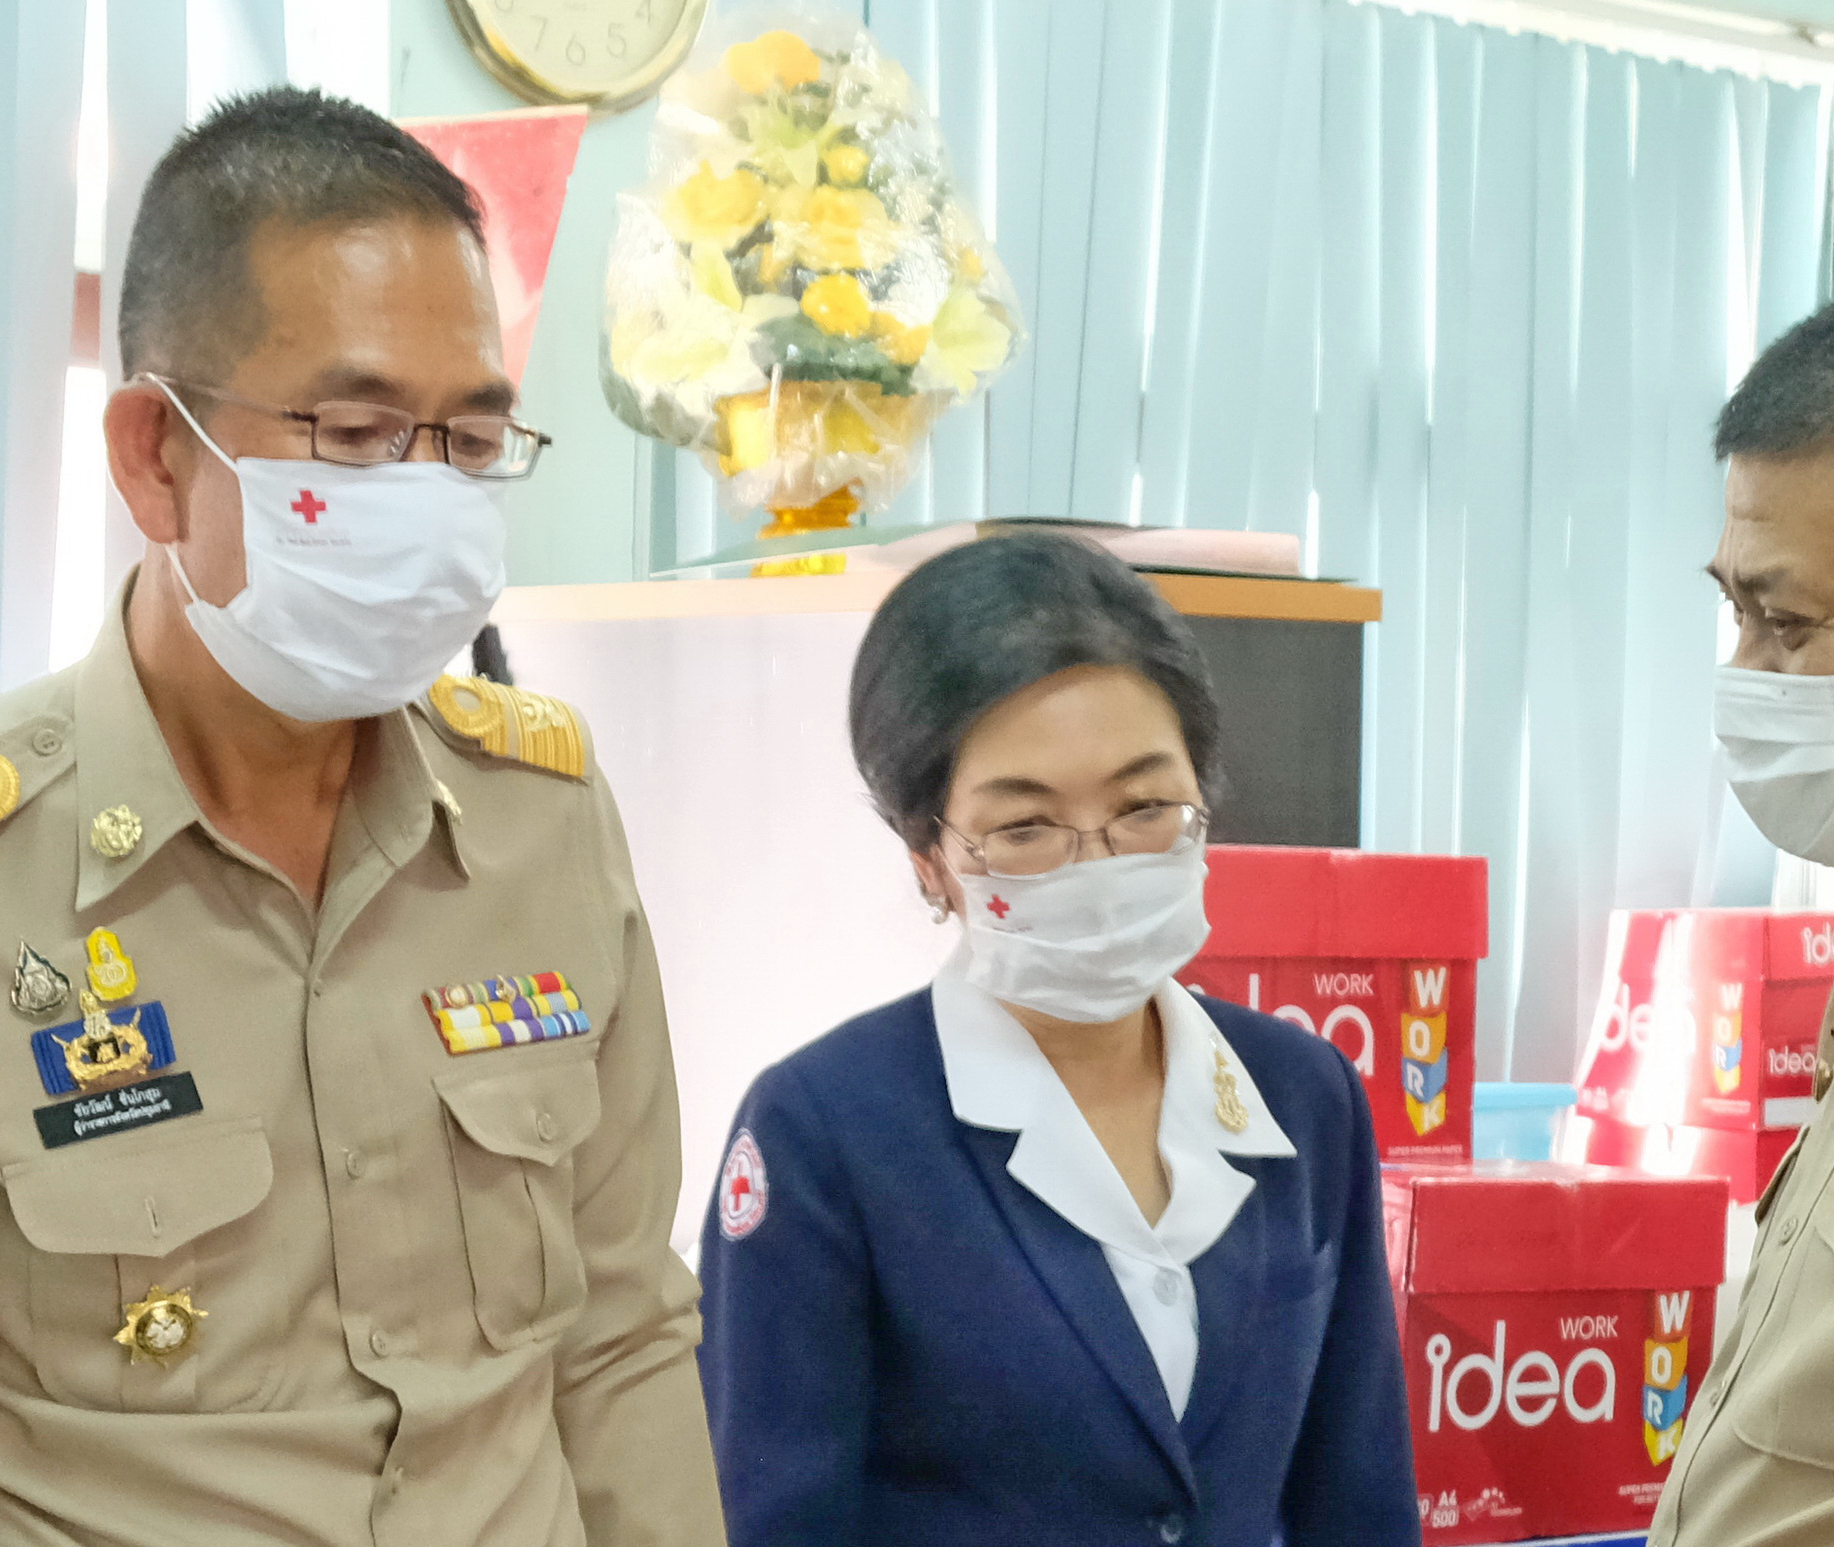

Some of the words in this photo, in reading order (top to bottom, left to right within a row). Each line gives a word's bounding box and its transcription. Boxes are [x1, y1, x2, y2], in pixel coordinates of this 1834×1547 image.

[565, 32, 586, 66] 6
[1313, 972, 1375, 997] WORK
[1407, 966, 1447, 1132] WORK
[1560, 1315, 1618, 1341] WORK
[1425, 1319, 1616, 1433] idea
[1647, 1290, 1691, 1461] WORK
[1432, 1509, 1458, 1528] 500
